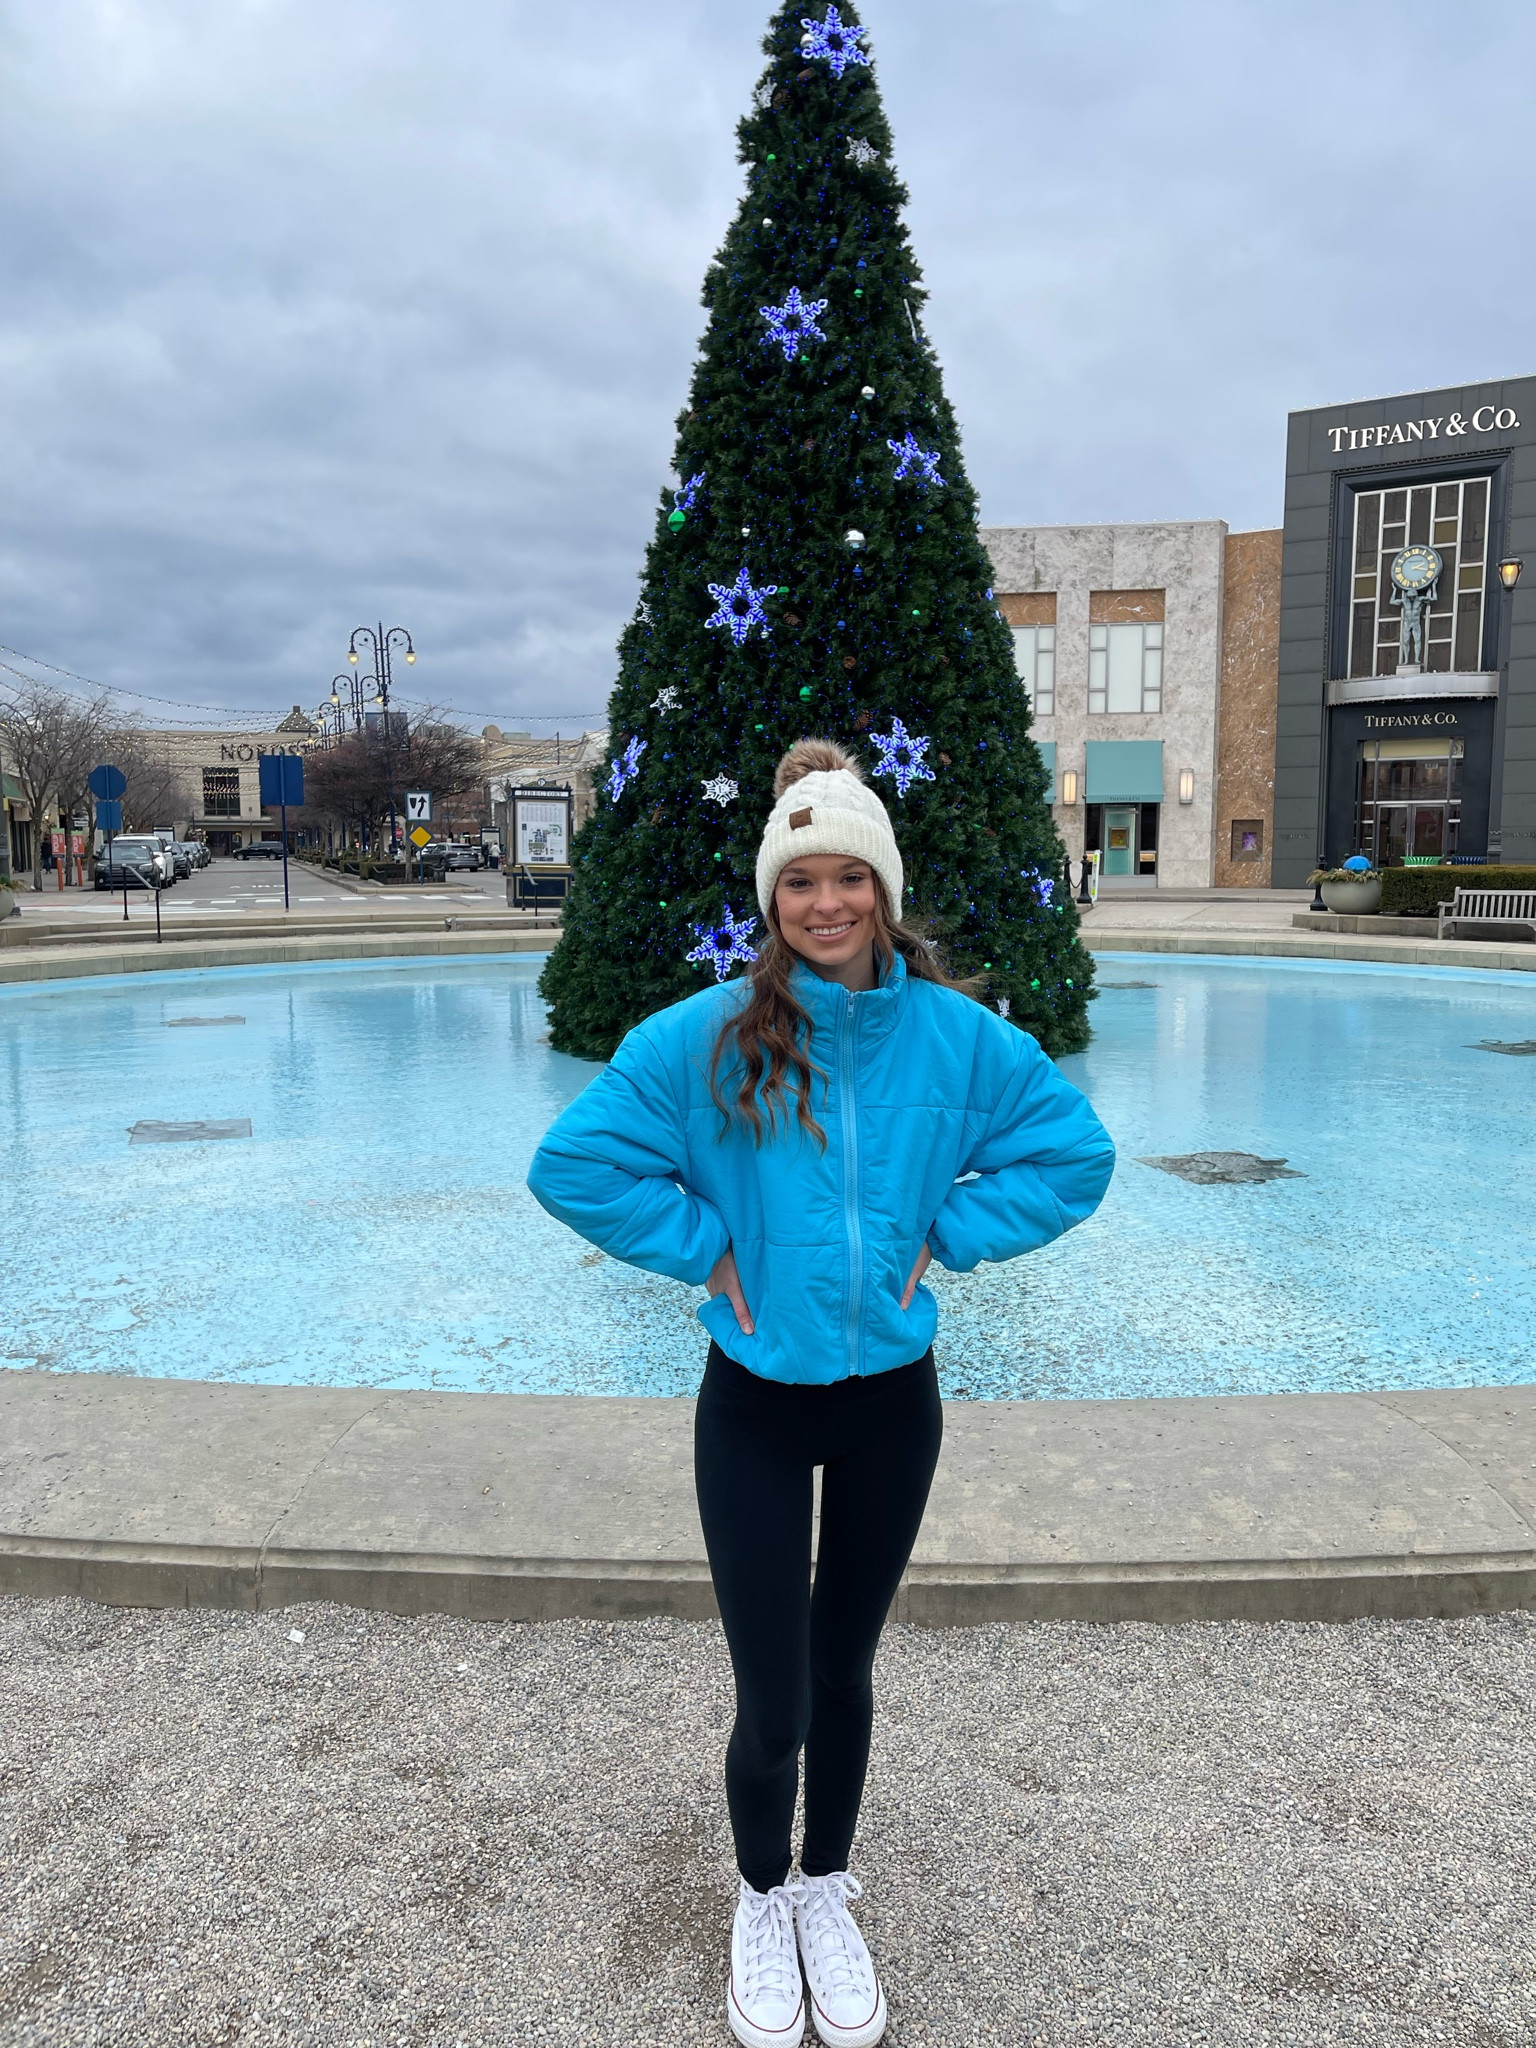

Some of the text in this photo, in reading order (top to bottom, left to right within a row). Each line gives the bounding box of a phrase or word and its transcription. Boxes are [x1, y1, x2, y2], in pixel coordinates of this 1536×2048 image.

[1328, 417, 1444, 452] TIFFANY
[1445, 412, 1468, 437] &
[1364, 715, 1421, 728] TIFFANY
[1421, 713, 1433, 725] &
